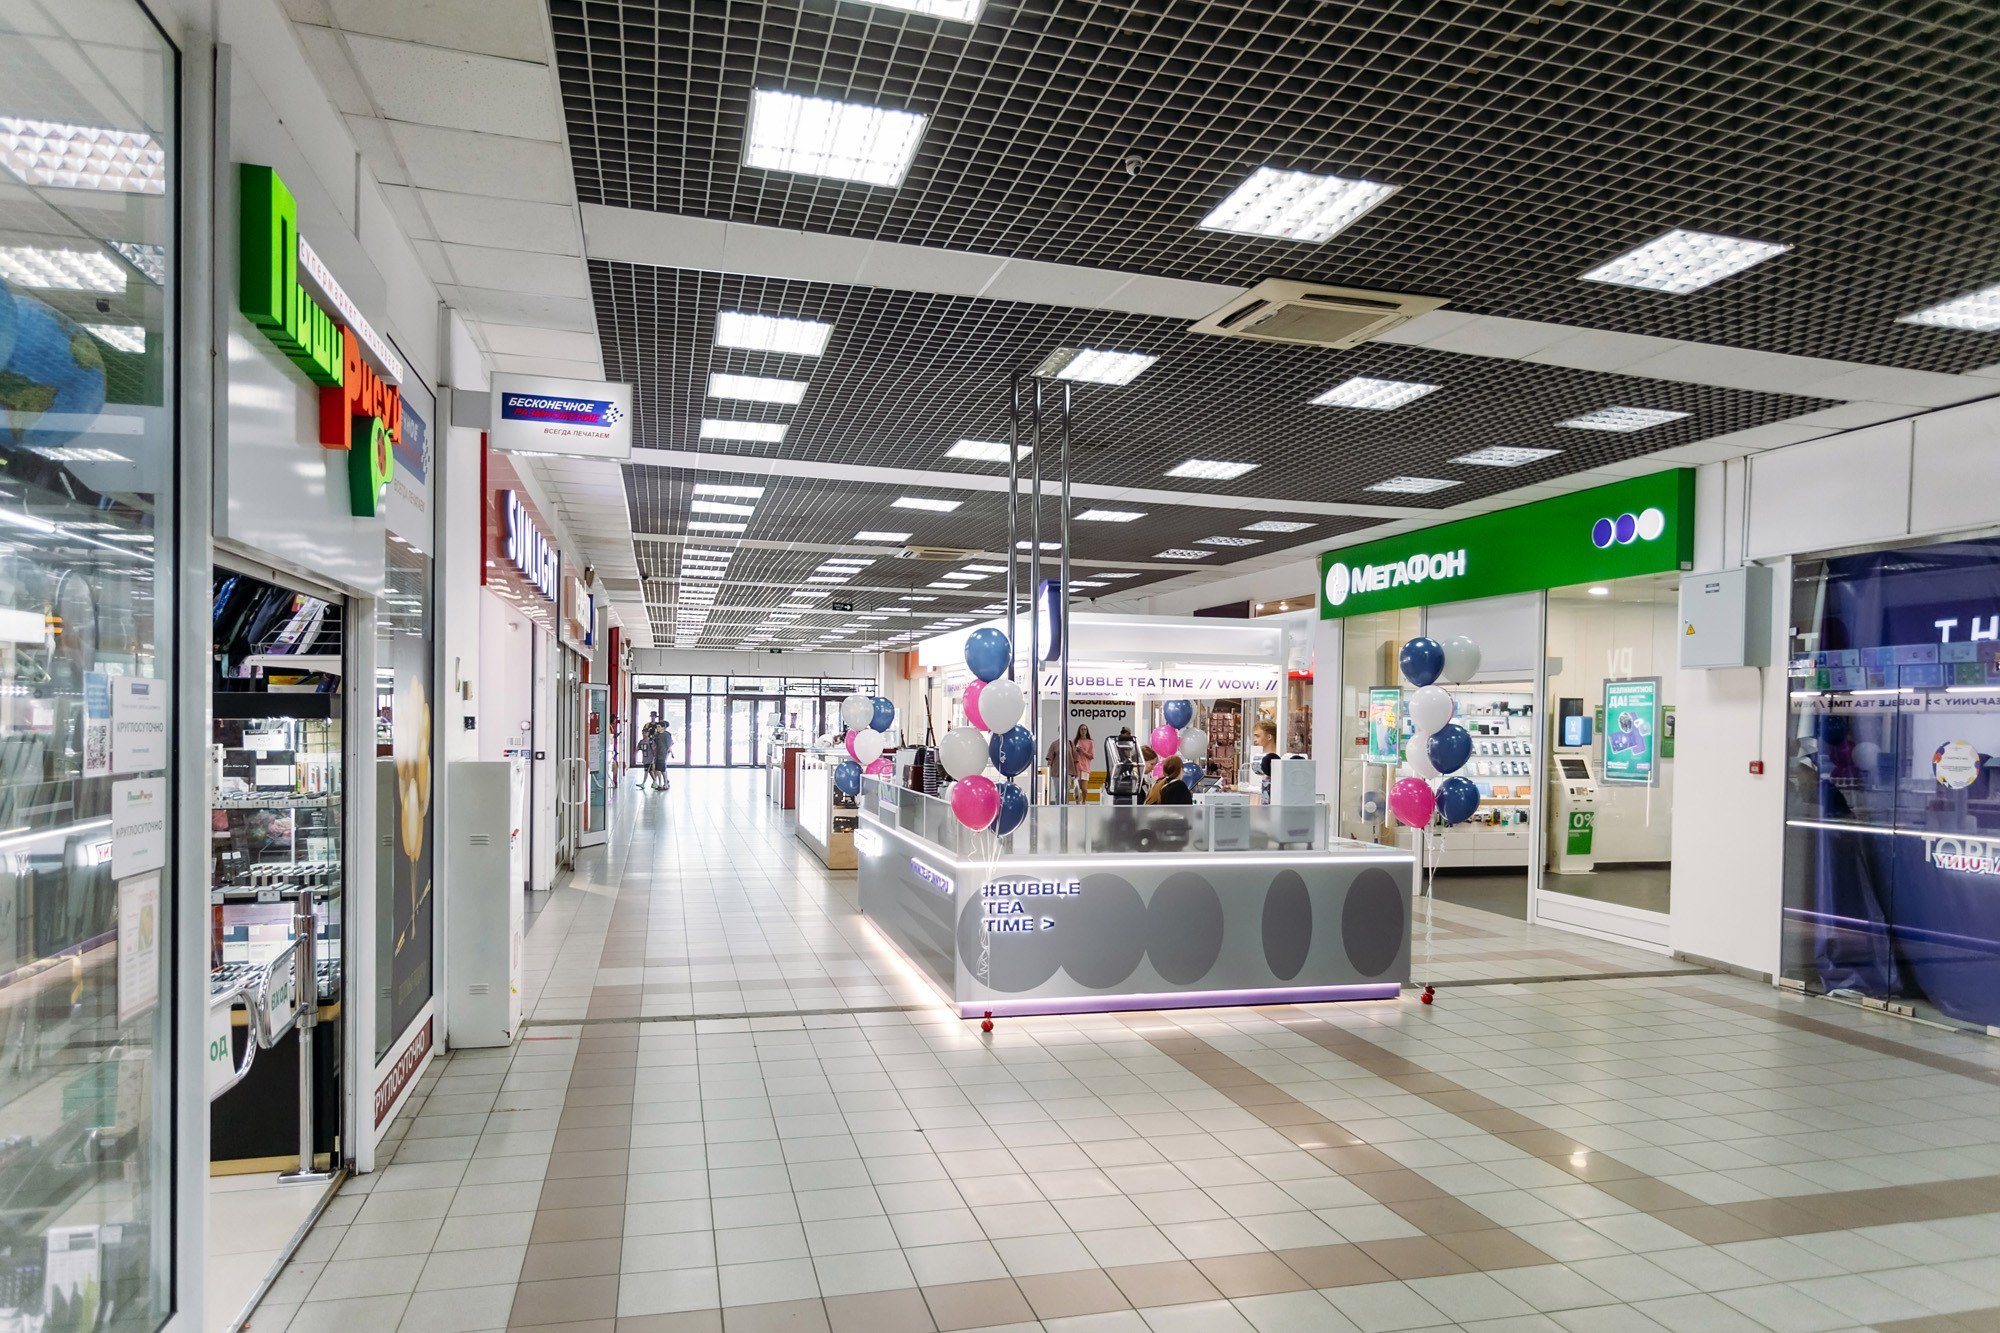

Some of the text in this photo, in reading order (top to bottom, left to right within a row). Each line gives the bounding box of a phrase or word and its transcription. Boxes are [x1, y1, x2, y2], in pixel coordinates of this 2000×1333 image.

[301, 242, 357, 319] супермаркет
[508, 397, 594, 413] БЕСКОНЕЧНОЕ
[513, 407, 600, 423] РАЗМНОЖЕНИЕ
[543, 427, 610, 439] ВСЕГДА ПЕЧАТАЕМ
[507, 489, 558, 603] SUNLIGHT
[1068, 676, 1123, 687] BUBBLE
[1128, 678, 1155, 687] TEA
[1160, 678, 1193, 688] TIME
[1218, 680, 1260, 690] WOW!
[1609, 695, 1628, 708] ДА!
[1070, 708, 1127, 720] оператор
[117, 722, 163, 733] КРУГЛОСУТОЧНО
[1573, 813, 1595, 828] 0%
[116, 820, 163, 838] КРУГЛОСУТОЧНО
[983, 882, 1080, 897] #BUBBLE
[984, 901, 1024, 914] TEA
[984, 919, 1034, 932] TIME
[271, 983, 288, 1011] ВХОД
[210, 1035, 228, 1062] ОД
[375, 1030, 425, 1119] РУГЛОСУТОЧНО
